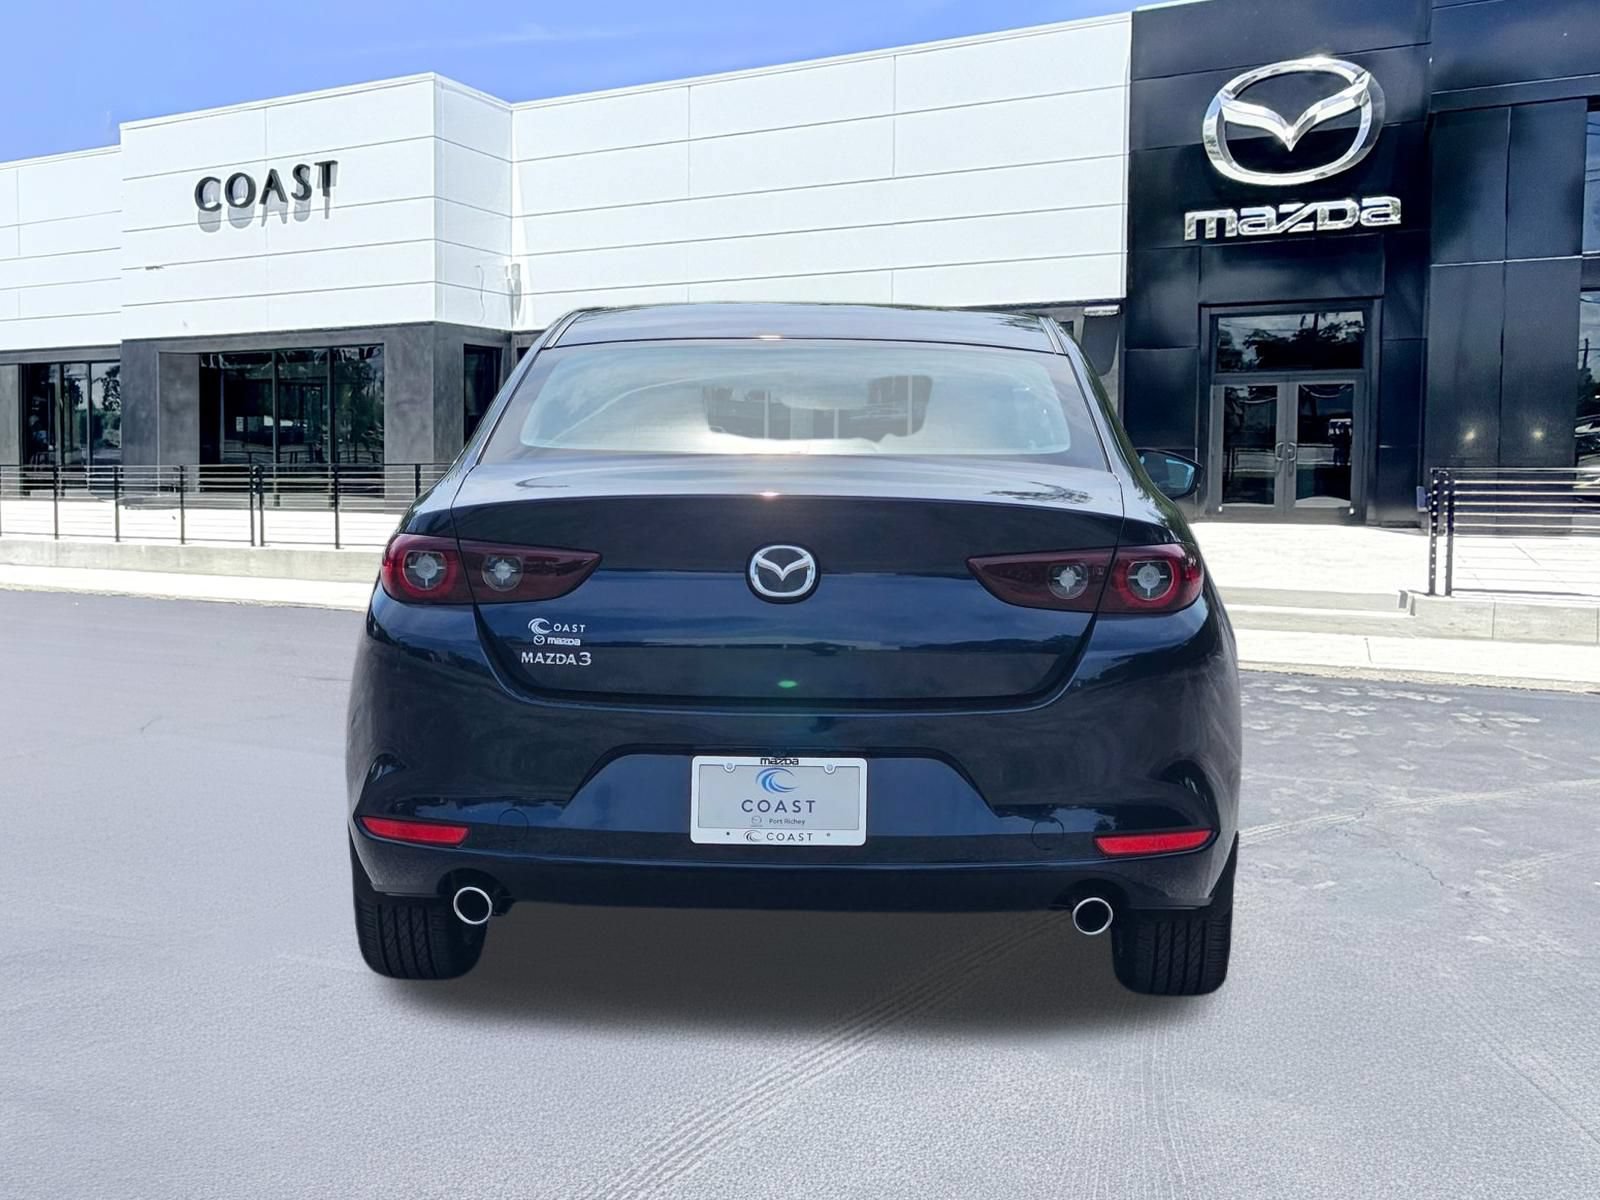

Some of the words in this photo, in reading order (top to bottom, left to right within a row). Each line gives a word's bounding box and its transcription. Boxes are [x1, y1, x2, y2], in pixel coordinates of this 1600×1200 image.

[194, 160, 338, 212] COAST
[741, 799, 816, 813] COAST
[784, 818, 805, 826] Richey
[766, 832, 813, 841] COAST
